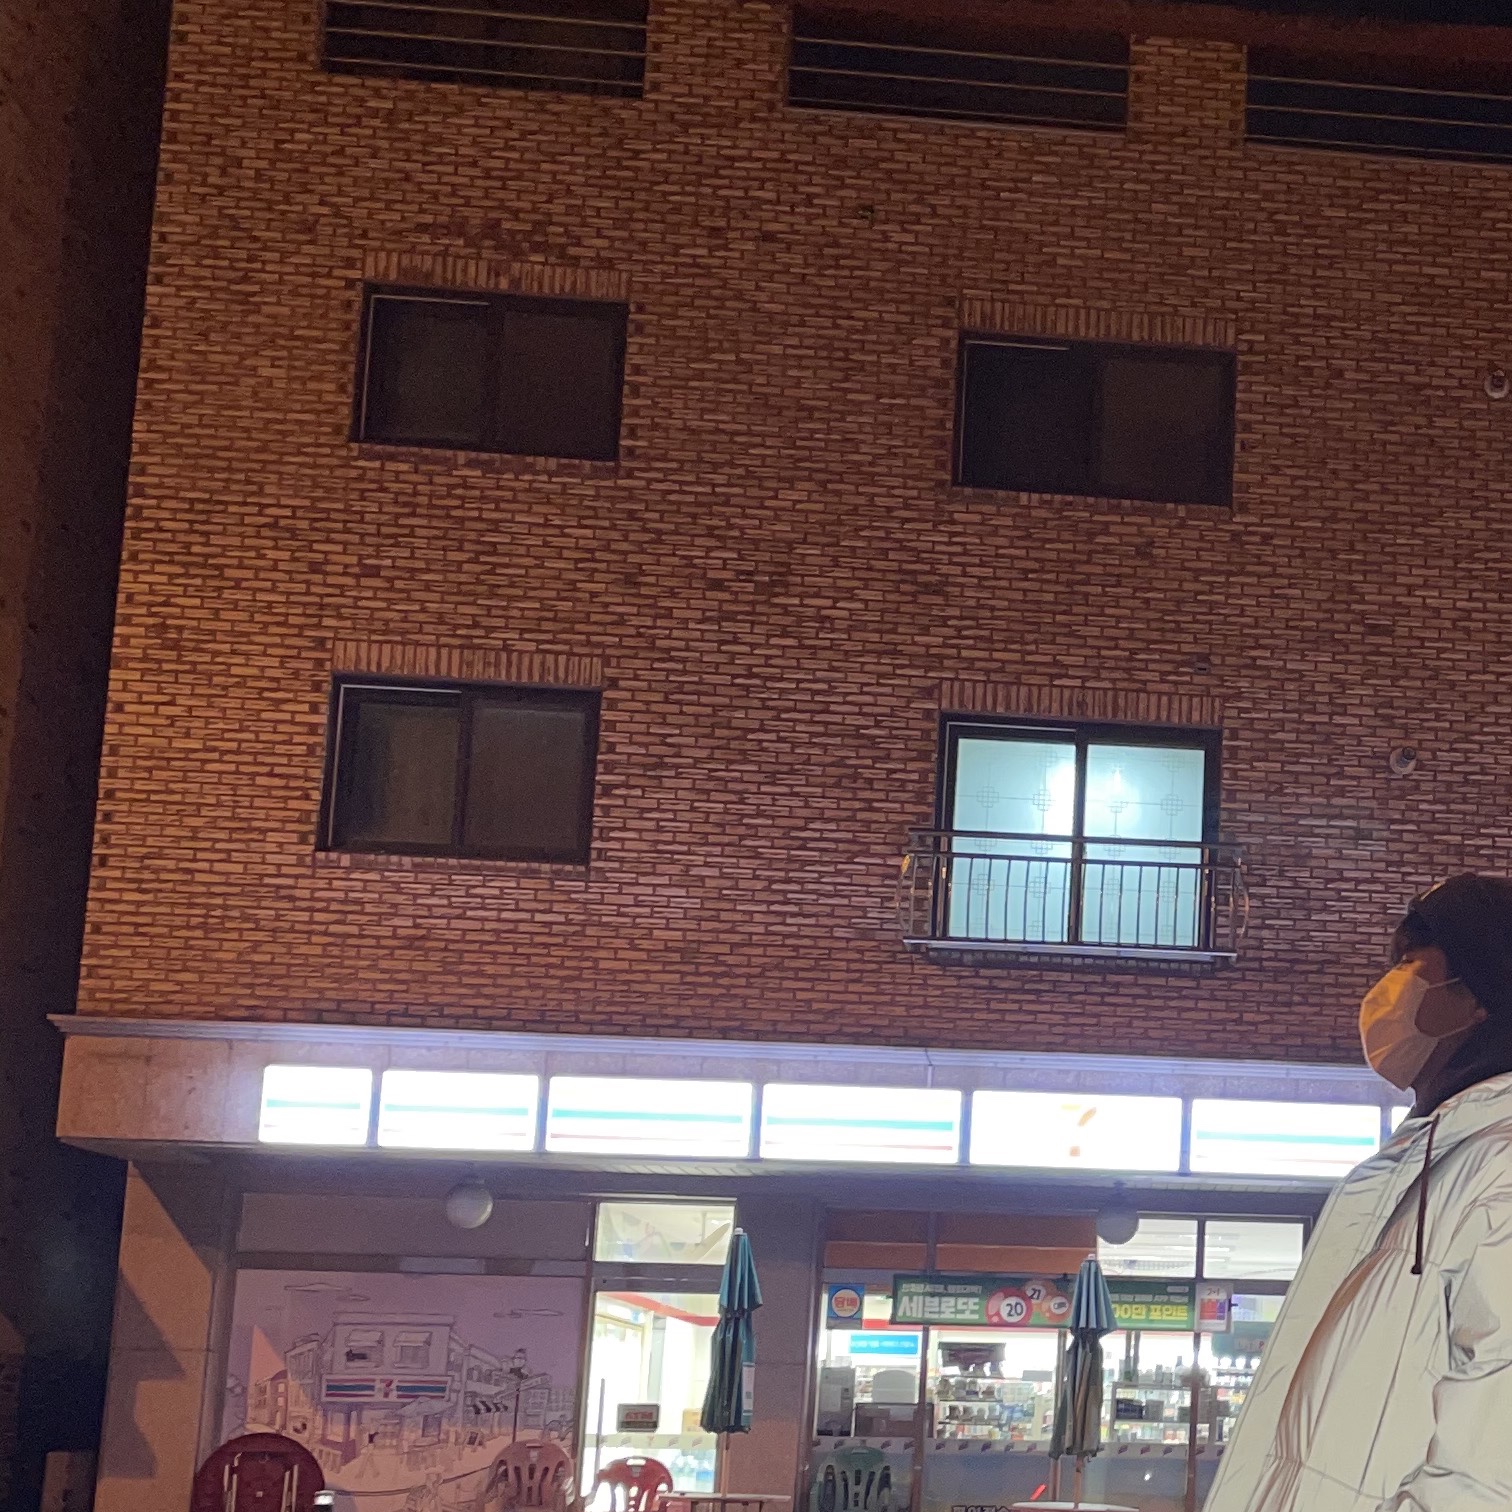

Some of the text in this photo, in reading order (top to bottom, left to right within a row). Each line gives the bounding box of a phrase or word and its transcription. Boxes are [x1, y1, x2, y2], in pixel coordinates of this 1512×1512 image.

[897, 1295, 980, 1319] 세븐로또
[1006, 1302, 1024, 1317] 20
[1149, 1305, 1189, 1321] 포인트
